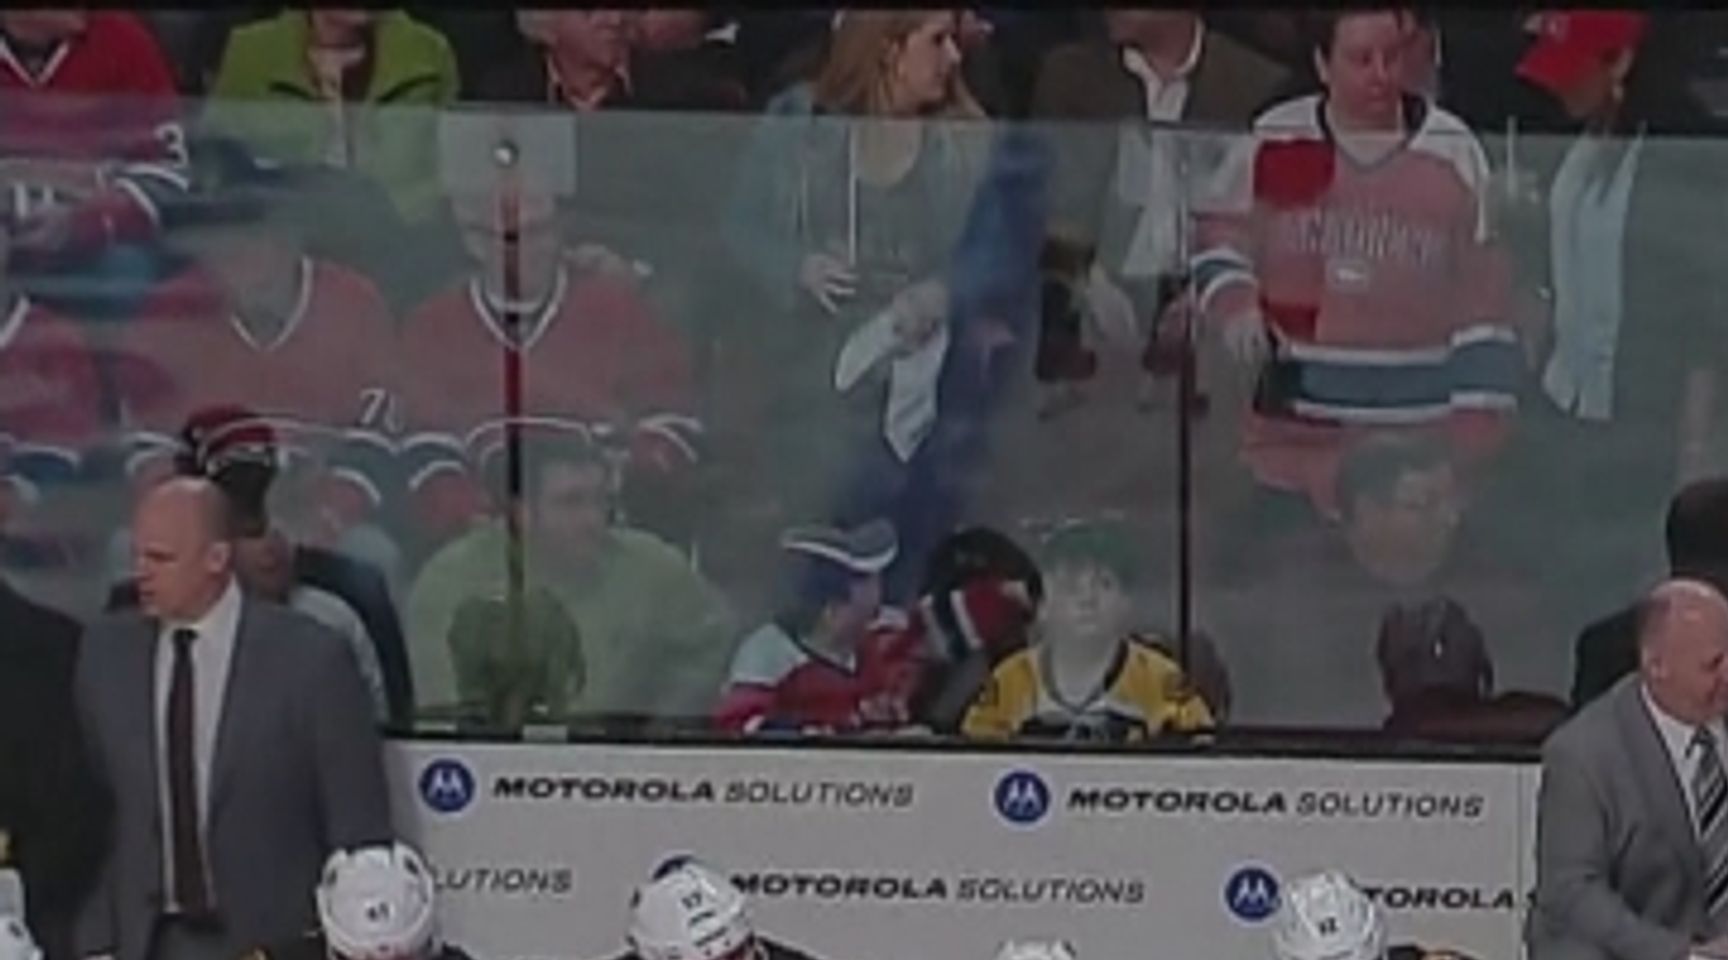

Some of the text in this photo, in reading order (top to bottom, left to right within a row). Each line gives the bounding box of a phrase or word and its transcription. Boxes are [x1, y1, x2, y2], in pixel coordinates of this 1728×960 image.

[493, 776, 716, 802] MOTOROLA
[724, 779, 915, 807] SOLUTIONS
[1067, 787, 1288, 813] MOTOROLA
[1296, 791, 1485, 819] SOLUTIONS
[432, 868, 573, 894] LUTIONS
[731, 873, 1147, 904] MOTOROLA SOLUTIONS
[1363, 886, 1515, 910] TOROLA
